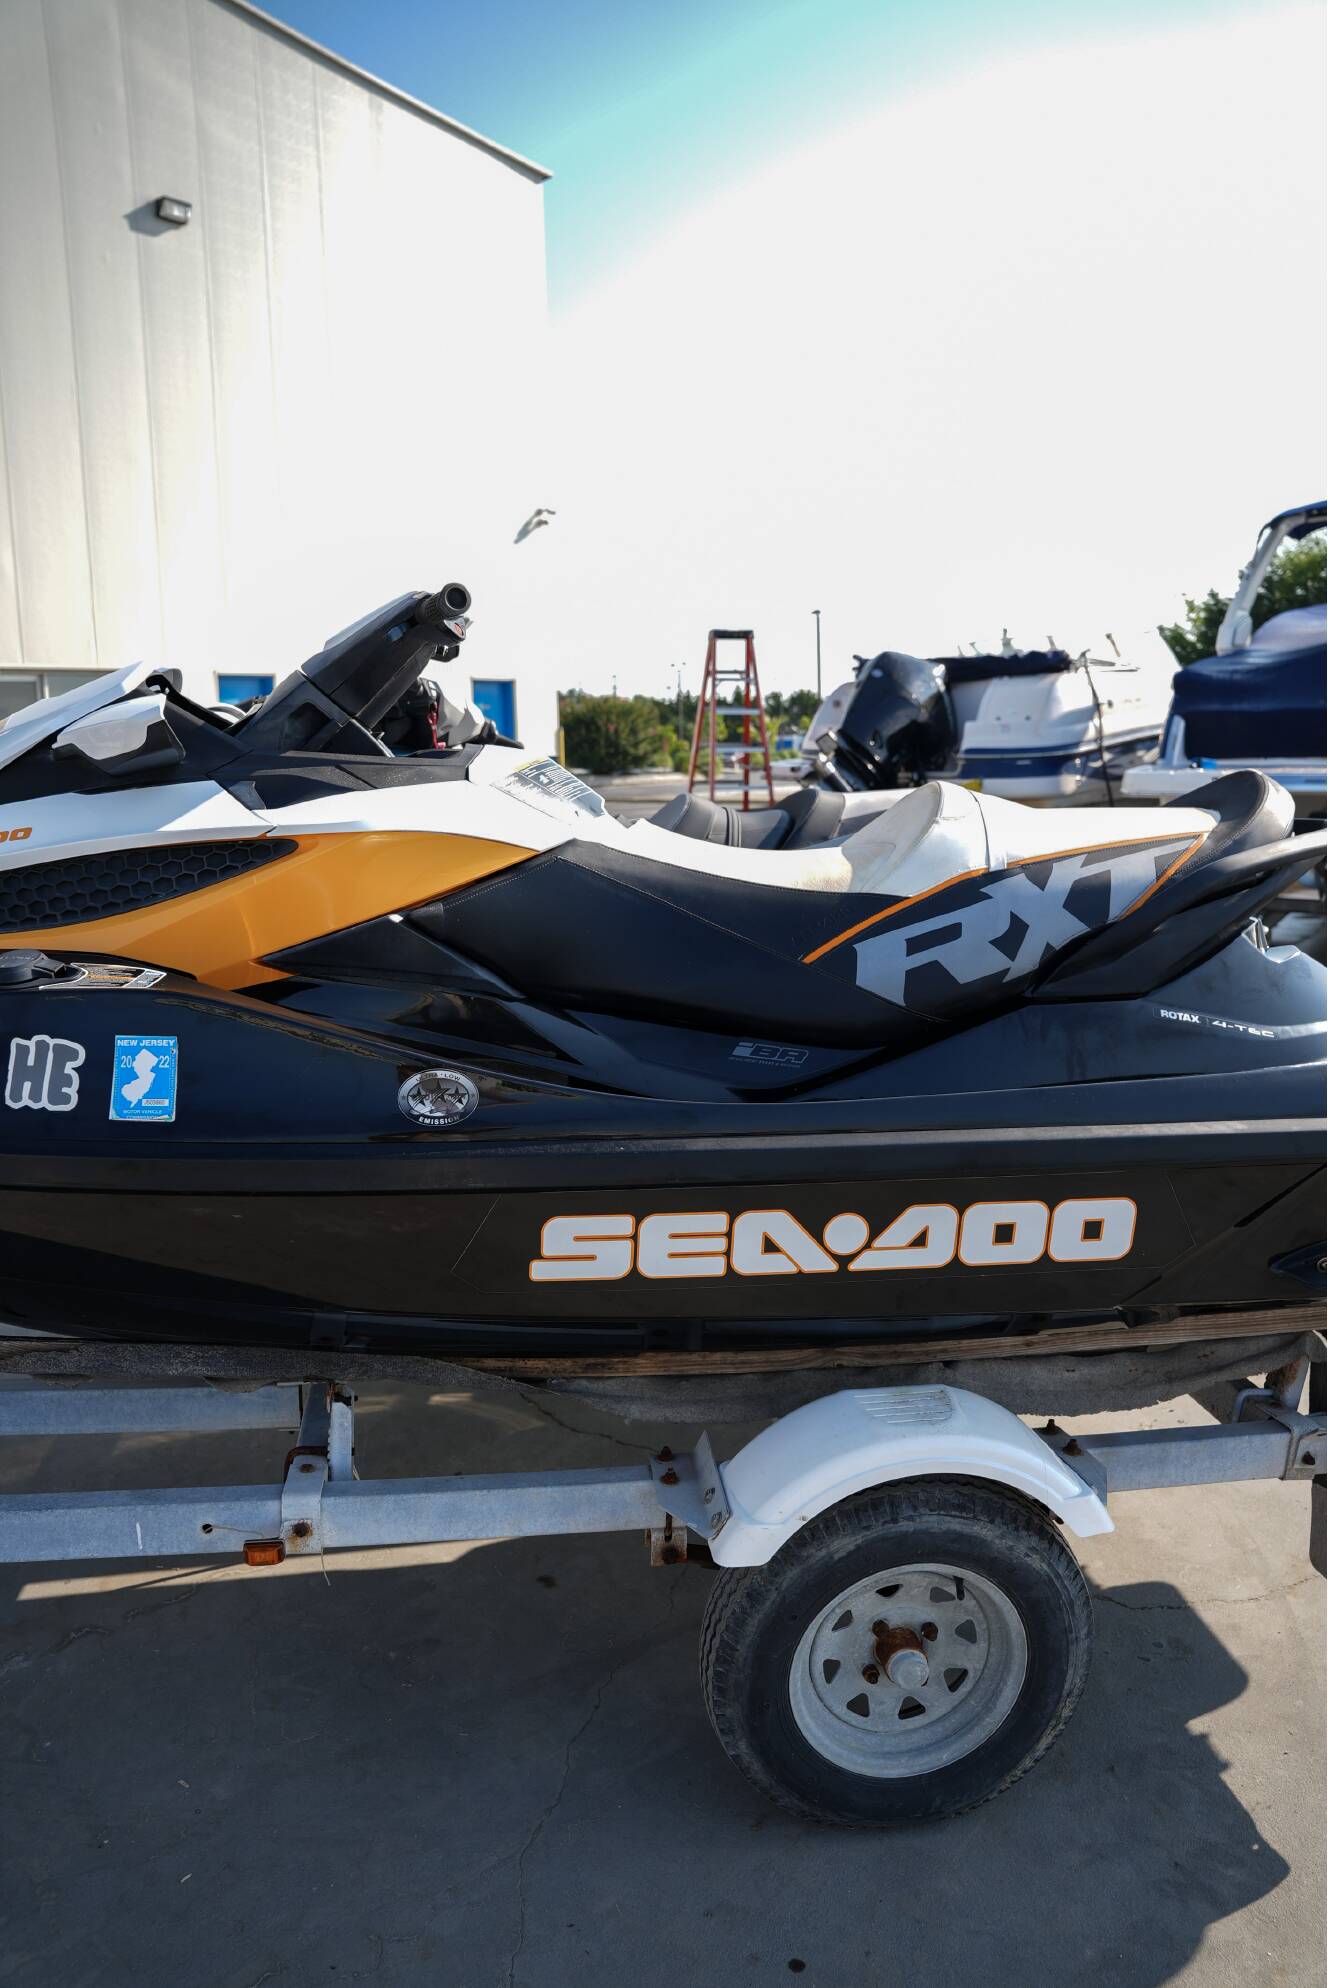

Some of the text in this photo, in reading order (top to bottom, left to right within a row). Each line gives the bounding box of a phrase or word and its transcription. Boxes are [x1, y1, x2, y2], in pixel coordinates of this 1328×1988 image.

[853, 838, 1197, 1006] RXT
[1160, 1009, 1275, 1038] ROTAX 4-TEC
[117, 1039, 175, 1047] NEW JERSEY
[120, 1055, 170, 1068] 20 22
[6, 1035, 85, 1111] HE
[444, 1073, 461, 1081] LOW
[418, 1115, 460, 1125] EMISSION
